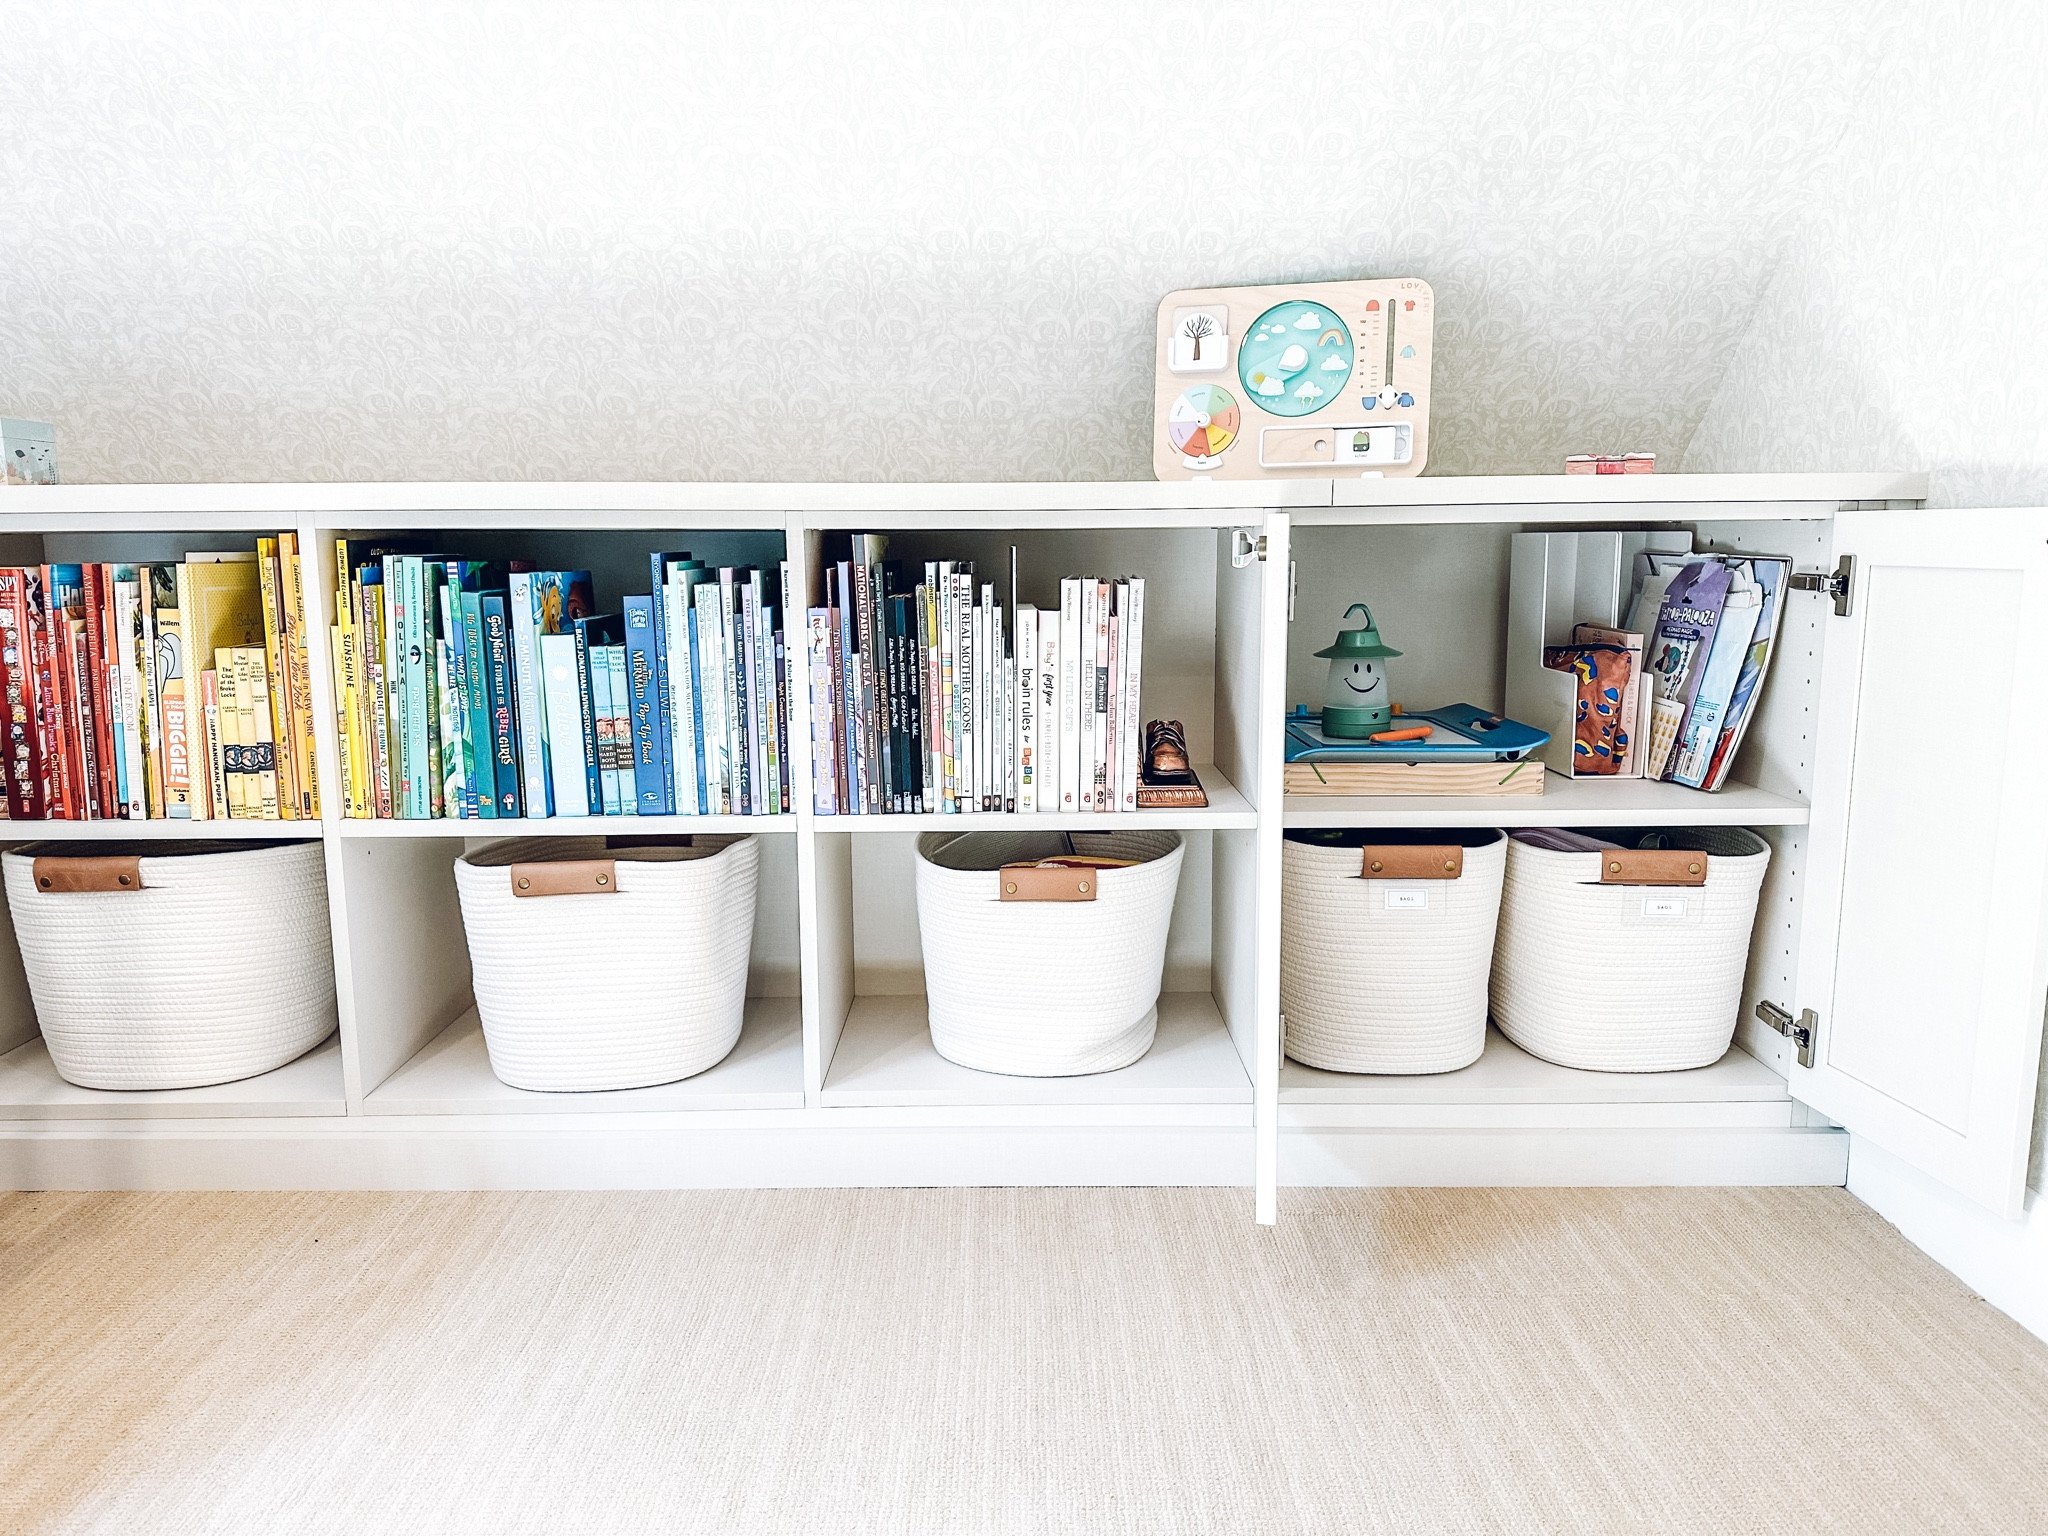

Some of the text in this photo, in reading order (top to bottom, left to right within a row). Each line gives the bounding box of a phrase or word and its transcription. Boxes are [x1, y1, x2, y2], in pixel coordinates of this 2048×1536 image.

[0, 576, 18, 592] SPY
[856, 565, 866, 610] NATIONAL
[84, 573, 97, 657] AMELIA BEDELIA
[859, 612, 868, 640] PARKS
[290, 642, 297, 653] is
[468, 628, 476, 645] IDEAS
[291, 656, 301, 683] New
[343, 634, 355, 688] SUNSHINE
[457, 655, 466, 679] WHAT
[961, 585, 970, 734] THE REAL MOTHER GOOSE
[1044, 642, 1055, 672] Baby's
[1066, 660, 1073, 673] MY
[471, 661, 479, 688] CURIOUS
[863, 663, 872, 688] U.S.A.
[1130, 673, 1137, 683] IN
[124, 676, 135, 731] IN MY ROOM
[294, 684, 303, 710] York
[376, 682, 385, 710] WOLFIE
[459, 692, 468, 714] LOVE?
[519, 634, 538, 765] 5-MINUTE STORIES
[575, 628, 584, 649] BACH
[586, 735, 594, 767] SEAGULL
[659, 670, 669, 718] SULWE
[1085, 690, 1092, 700] IN
[1130, 685, 1137, 699] MY
[276, 686, 286, 728] Gaston
[495, 664, 514, 764] STORIES REBEL GIRLS
[633, 651, 652, 764] MERMAID Pop-Up Book
[1022, 702, 1033, 730] rules
[46, 707, 54, 723] Blue
[51, 754, 60, 798] Christmas
[166, 711, 190, 785] BIGGIE!
[413, 732, 421, 746] Six
[212, 742, 220, 782] HANUKKAH,
[1022, 748, 1032, 784] BABY
[178, 794, 186, 802] 3
